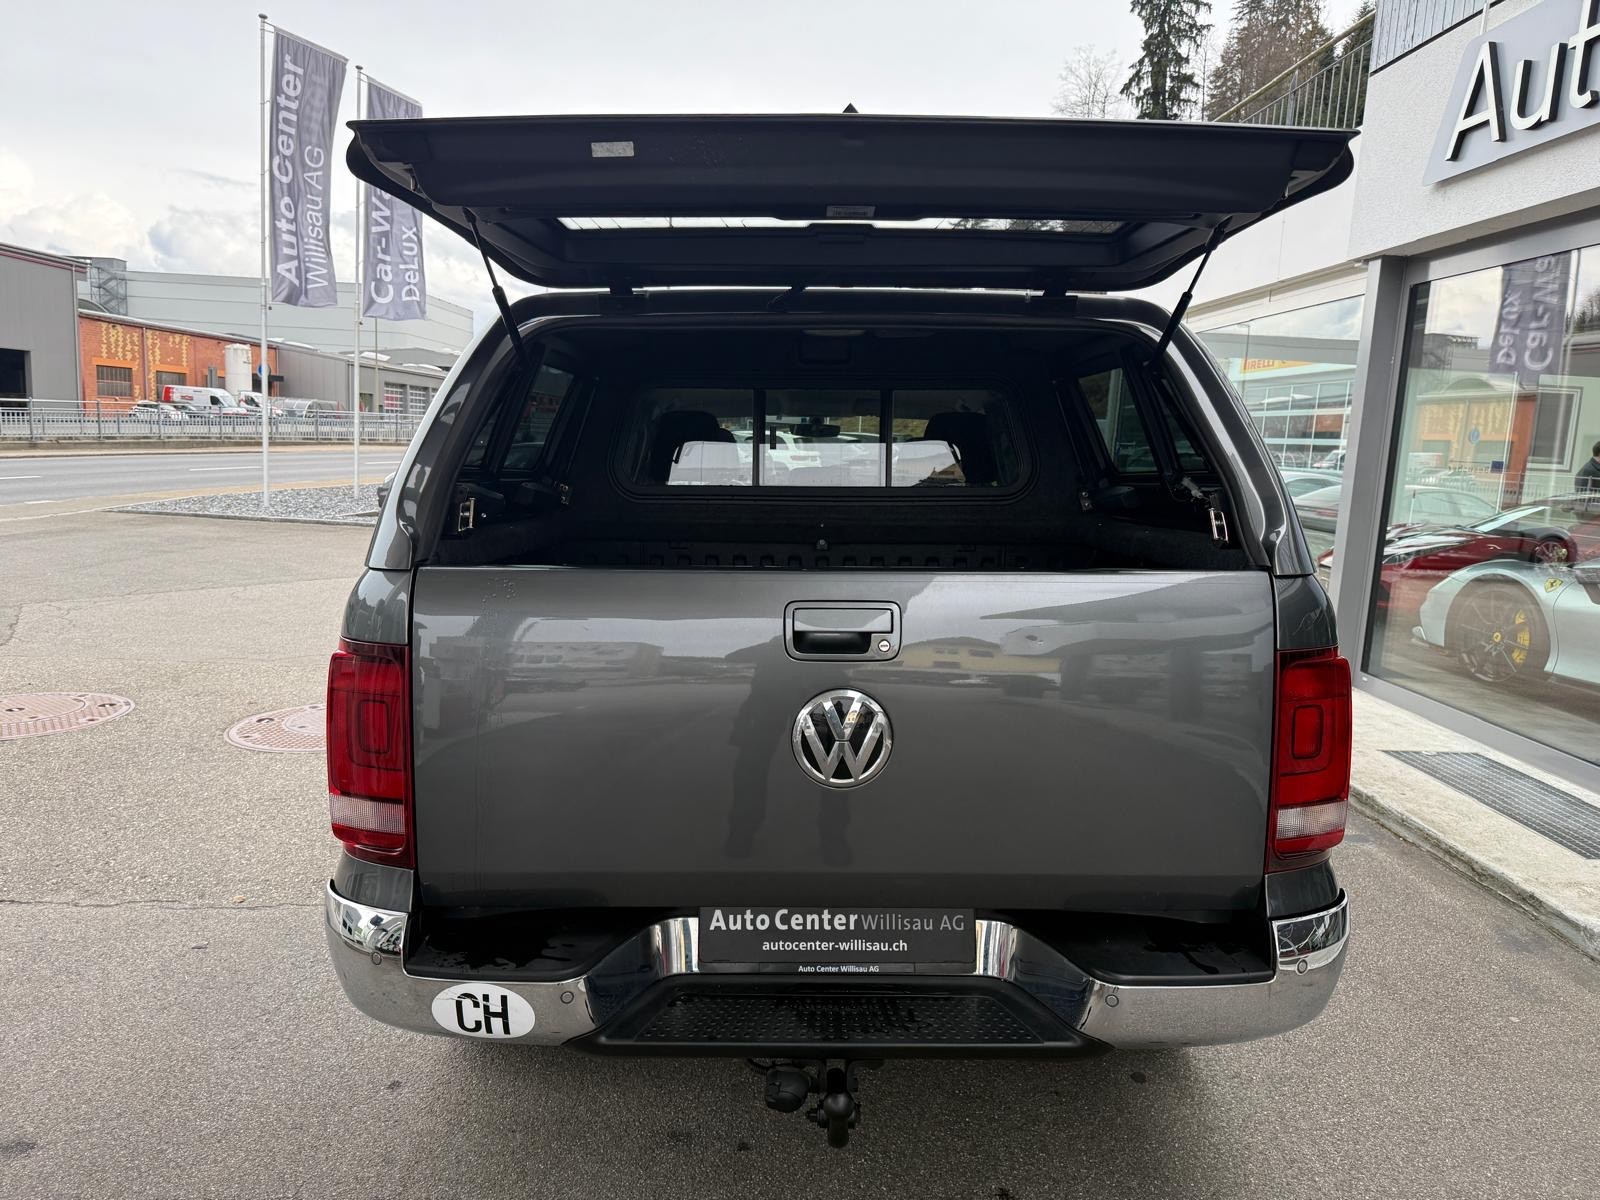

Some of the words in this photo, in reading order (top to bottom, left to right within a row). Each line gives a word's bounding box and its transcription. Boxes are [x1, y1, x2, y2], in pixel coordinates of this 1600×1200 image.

[272, 54, 304, 184] Center
[303, 145, 325, 190] AG
[275, 196, 299, 287] Auto
[304, 195, 328, 288] Willisau
[709, 909, 770, 931] Auto
[775, 909, 858, 931] Center
[861, 914, 933, 930] Willisau
[940, 915, 964, 930] AG
[762, 939, 908, 951] autocenter-willisau.ch
[798, 965, 815, 973] Auto
[816, 965, 839, 973] Center
[840, 965, 867, 973] Willisau
[868, 965, 880, 973] AG
[455, 992, 511, 1035] CH
